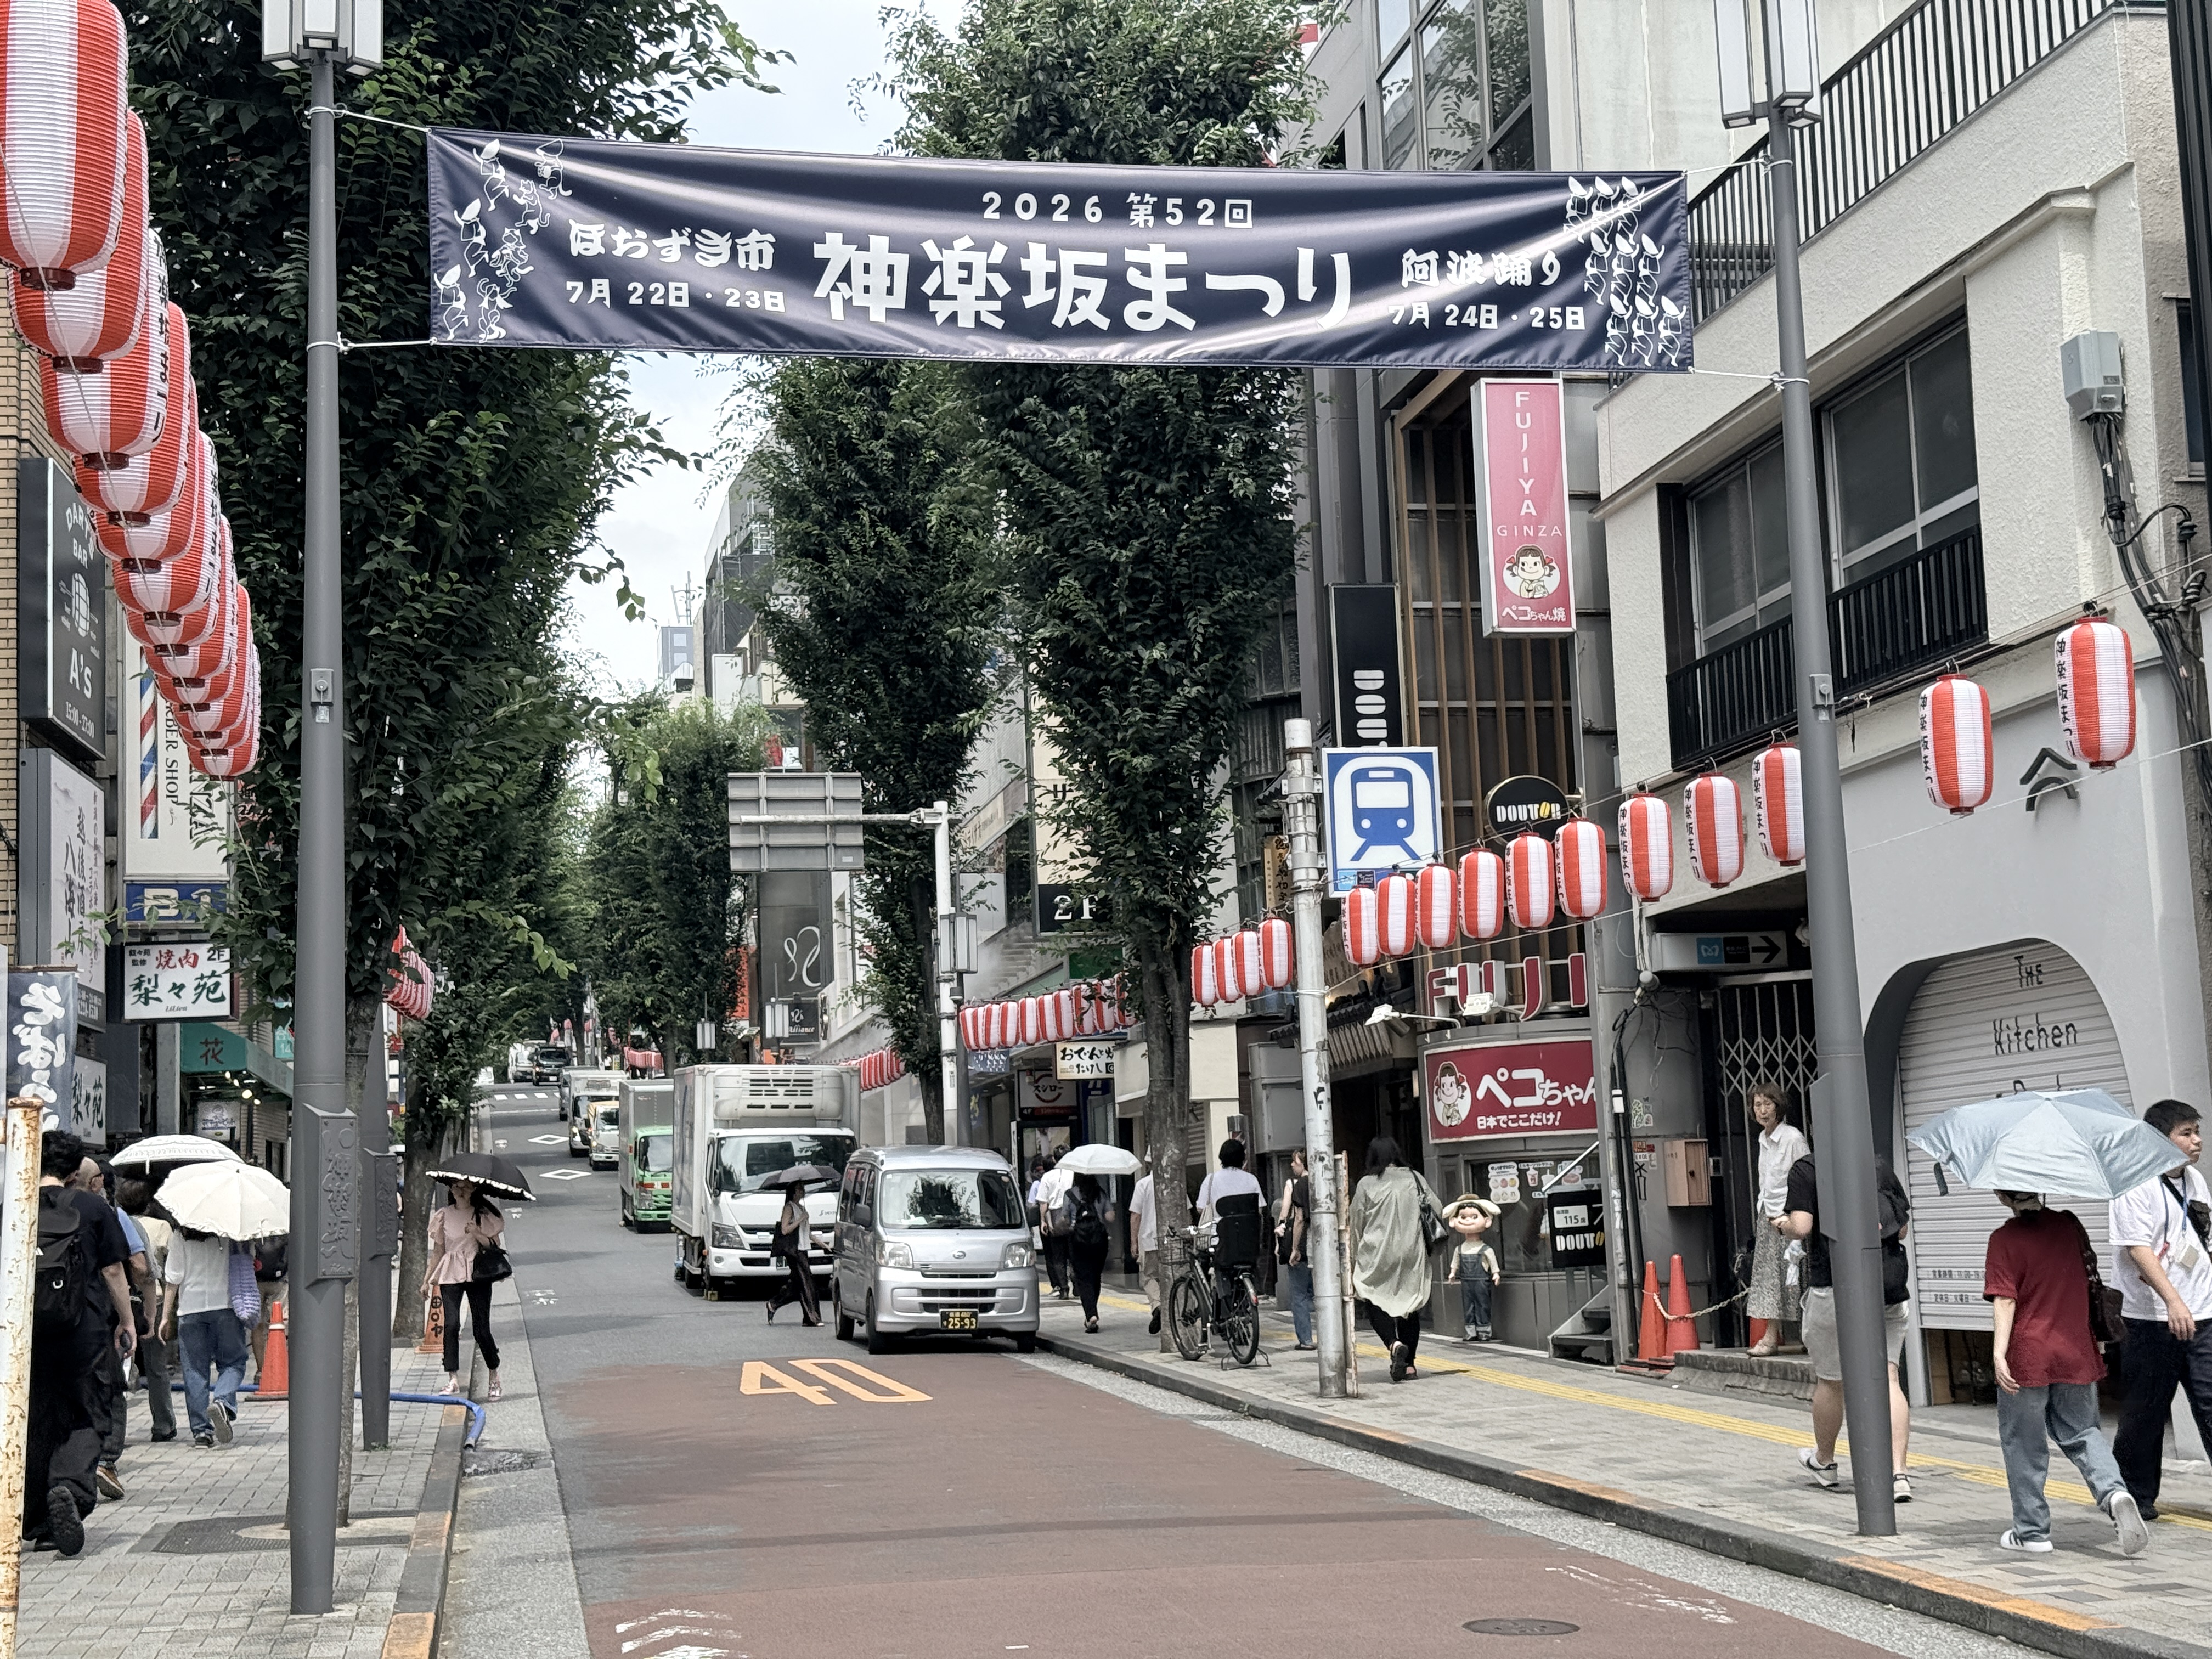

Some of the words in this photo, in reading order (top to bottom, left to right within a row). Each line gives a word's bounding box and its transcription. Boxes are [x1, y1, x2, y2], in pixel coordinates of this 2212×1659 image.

[982, 191, 1103, 222] 2026
[1126, 192, 1254, 229] 第52回
[569, 221, 776, 272] ほおずき市
[814, 232, 1352, 332] 神楽坂まつり
[1400, 248, 1561, 289] 阿波踊り
[1515, 391, 1538, 516] FUJIYA
[1497, 524, 1562, 537] GINZA
[73, 538, 88, 569] BAR
[1502, 606, 1566, 622] ペコちゃん焼
[166, 757, 179, 805] SHOP
[1496, 801, 1561, 822] DOUTOR
[64, 835, 76, 959] 八海山
[1054, 894, 1098, 921] 2F
[156, 948, 200, 969] 焼肉
[206, 948, 225, 962] 2F
[129, 970, 226, 1007] 梨々苑
[1993, 1012, 2078, 1056] Kitchen
[199, 1037, 224, 1066] 花
[1076, 1063, 1103, 1074] たけし
[72, 1071, 104, 1128] 梨々苑
[1033, 1085, 1064, 1094] スシロー
[948, 1318, 977, 1329] 25-93
[740, 1358, 933, 1406] 40
